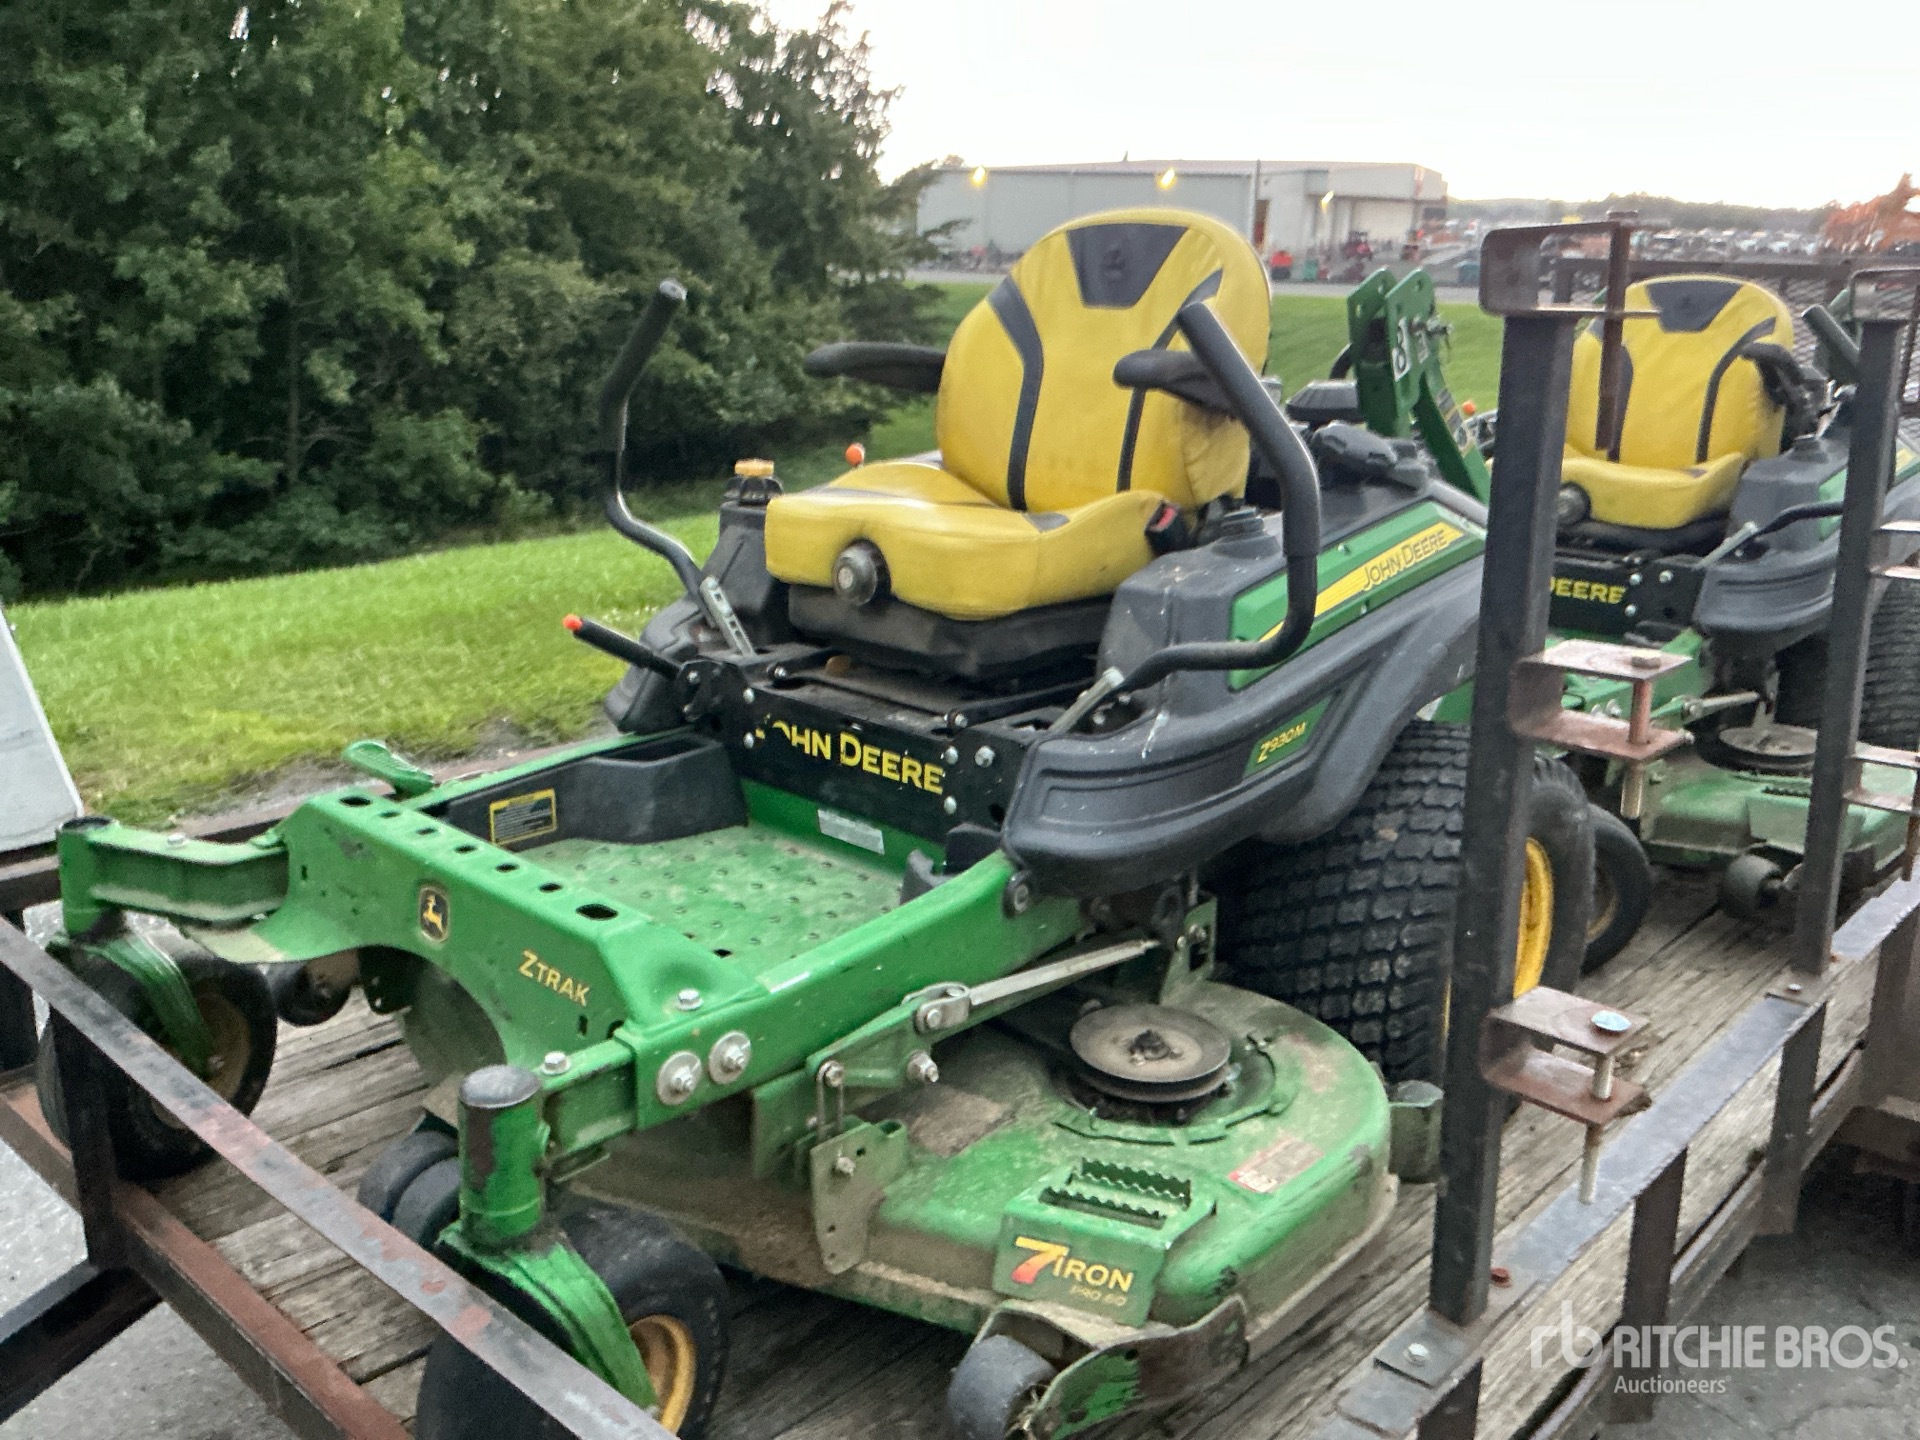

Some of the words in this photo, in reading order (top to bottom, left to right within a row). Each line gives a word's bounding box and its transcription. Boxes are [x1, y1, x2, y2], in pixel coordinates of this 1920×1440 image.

[1362, 554, 1402, 591] JOHN
[1401, 529, 1448, 567] DEERE
[840, 732, 944, 795] DEERE
[519, 950, 590, 1007] ZTRAK
